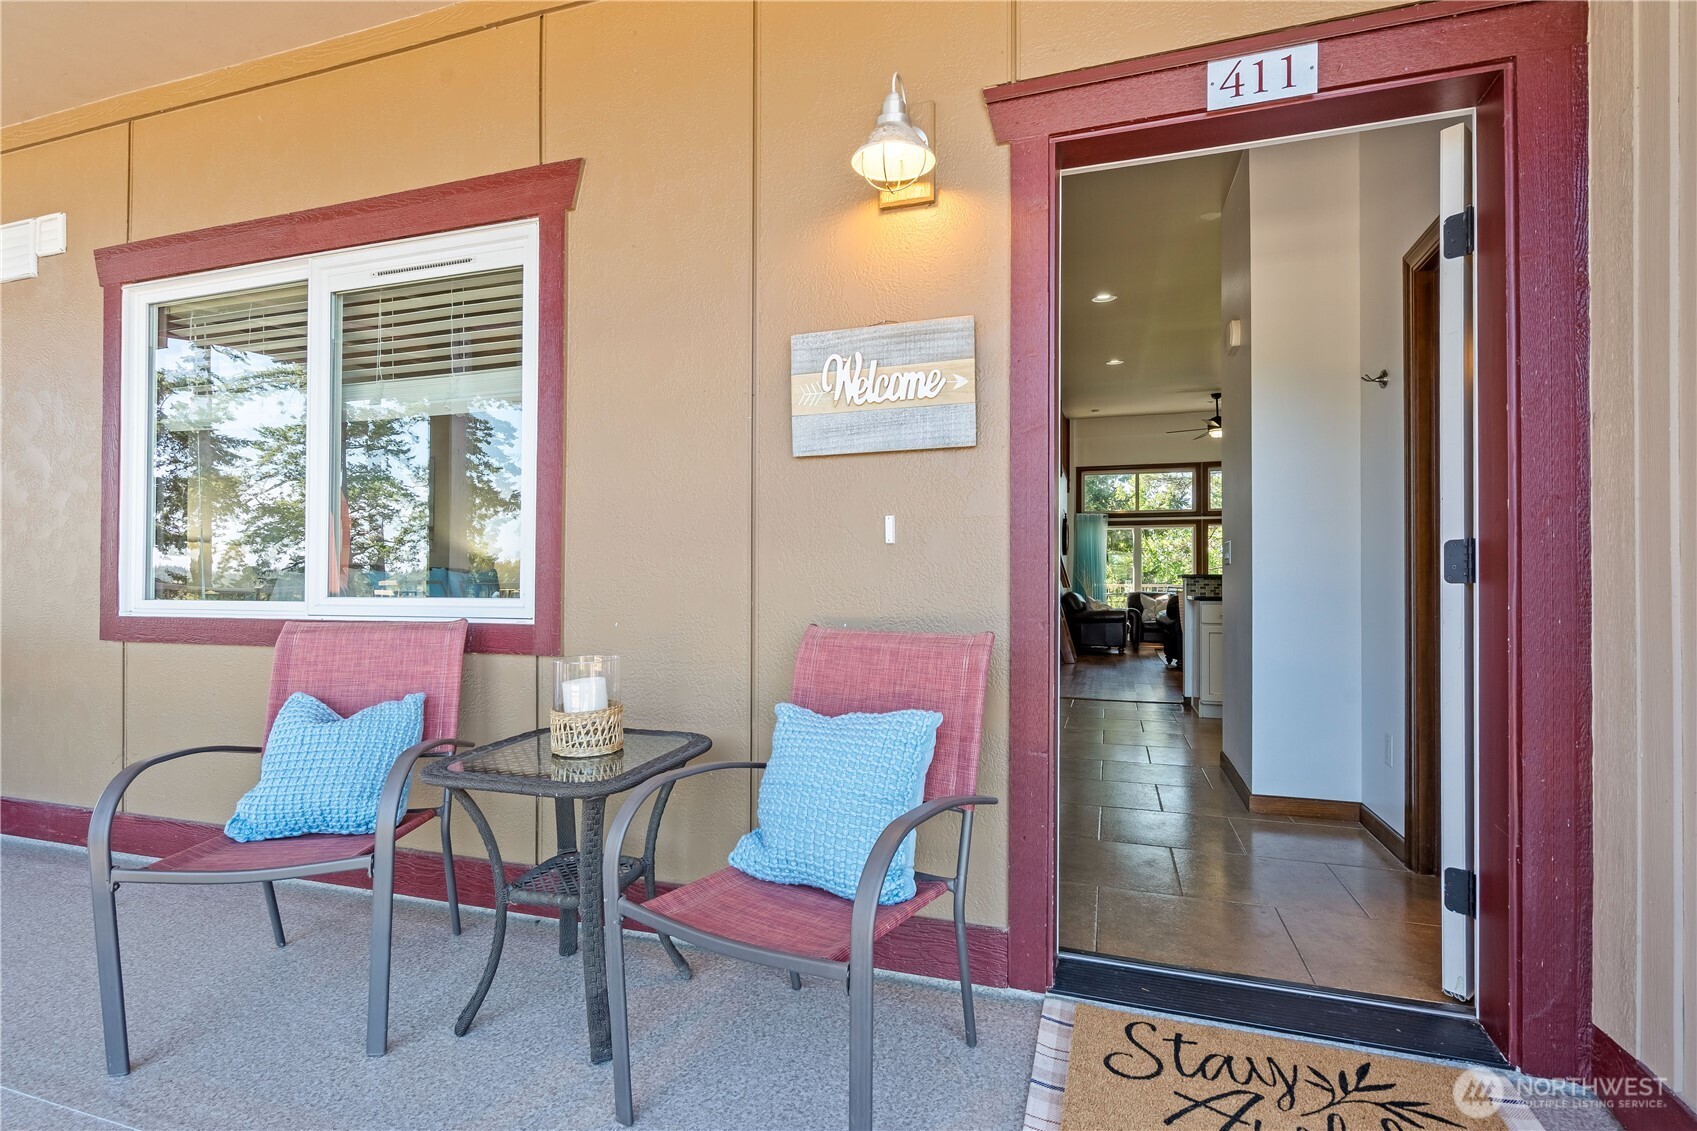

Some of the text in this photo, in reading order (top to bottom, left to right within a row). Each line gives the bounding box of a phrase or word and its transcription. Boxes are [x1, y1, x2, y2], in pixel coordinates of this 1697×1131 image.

[1219, 54, 1297, 98] 411
[821, 351, 947, 407] Welcome
[1103, 1021, 1298, 1111] Stay
